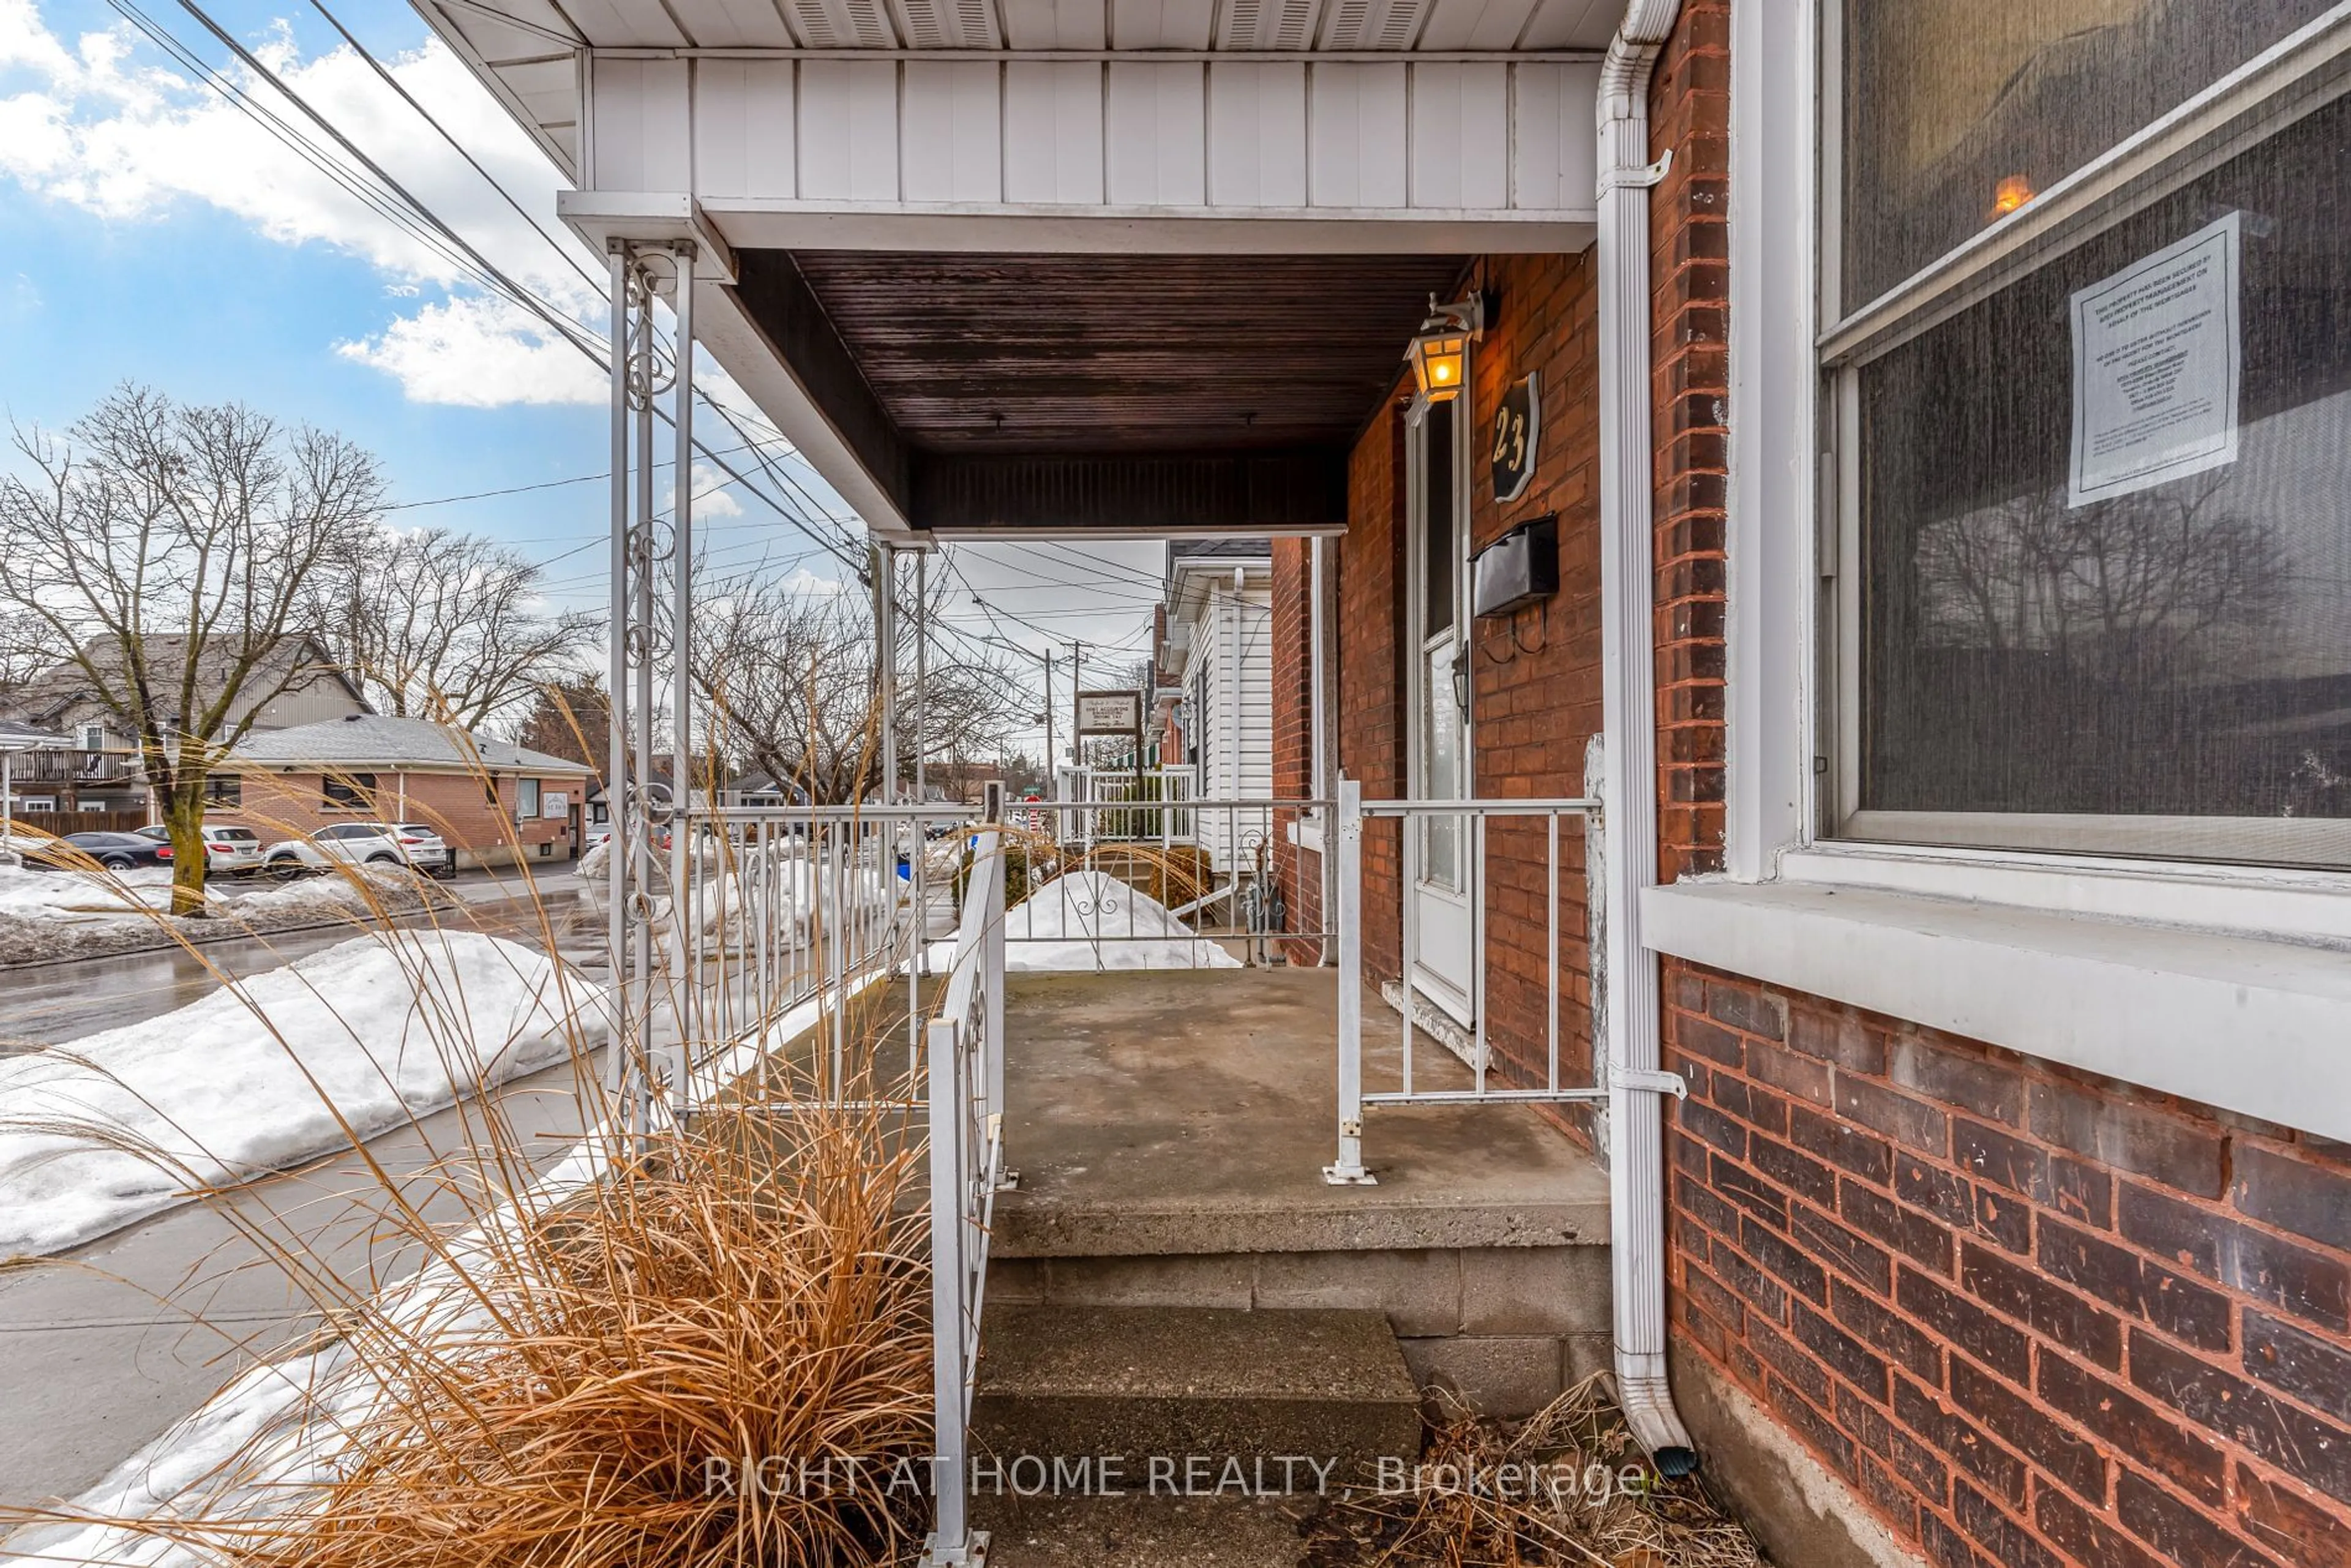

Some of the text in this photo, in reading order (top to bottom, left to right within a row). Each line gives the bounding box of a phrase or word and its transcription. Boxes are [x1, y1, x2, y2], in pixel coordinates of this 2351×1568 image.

[2108, 315, 2129, 329] BEHALF
[2140, 304, 2153, 313] THE
[2154, 285, 2197, 307] MORTGAGEE
[2109, 291, 2137, 309] PROPERTY
[2138, 283, 2152, 295] HAS
[2153, 276, 2171, 287] BEEN
[2172, 259, 2202, 279] SECURED
[2114, 297, 2144, 315] PROPERTY
[2145, 273, 2195, 301] MANAGEMENT
[2196, 267, 2208, 278] ON
[2149, 324, 2176, 340] WITHOUT
[2128, 354, 2148, 367] PLEASE
[1493, 407, 1524, 471] 23
